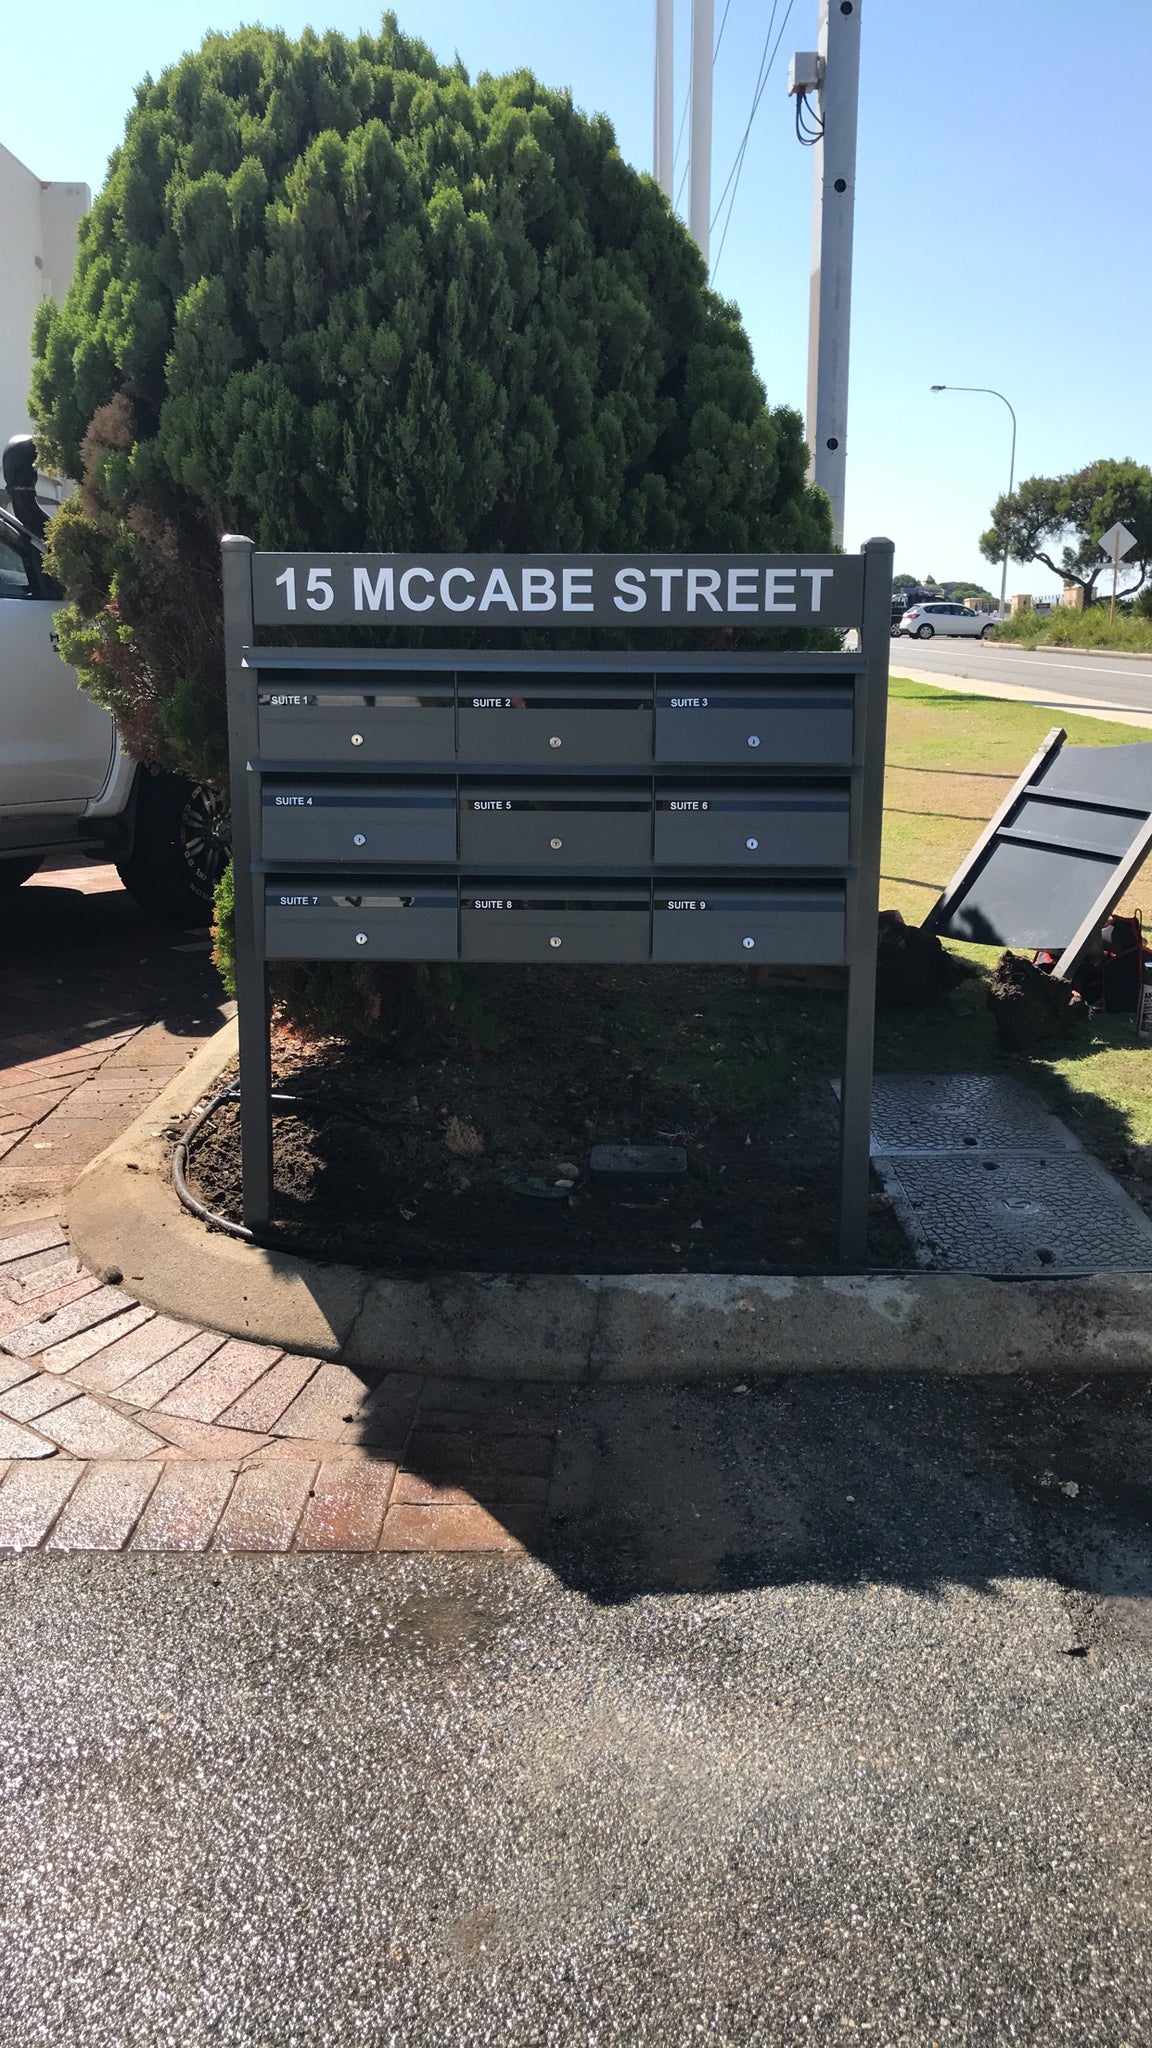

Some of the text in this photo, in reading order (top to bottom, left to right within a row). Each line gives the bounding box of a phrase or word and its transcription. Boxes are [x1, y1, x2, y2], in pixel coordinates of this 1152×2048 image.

[275, 567, 834, 613] 15 MCCABE STREET
[271, 695, 308, 705] SUITE 1
[472, 698, 511, 708] SUITE 2
[670, 697, 708, 708] SUITE 3
[275, 796, 313, 806] SUITE 4
[473, 801, 512, 810] SUITE 5
[670, 801, 708, 811] SUITE 6
[280, 896, 318, 905] SUITE 7
[474, 900, 513, 909] SUITE 8
[667, 901, 706, 910] SUITE 9
